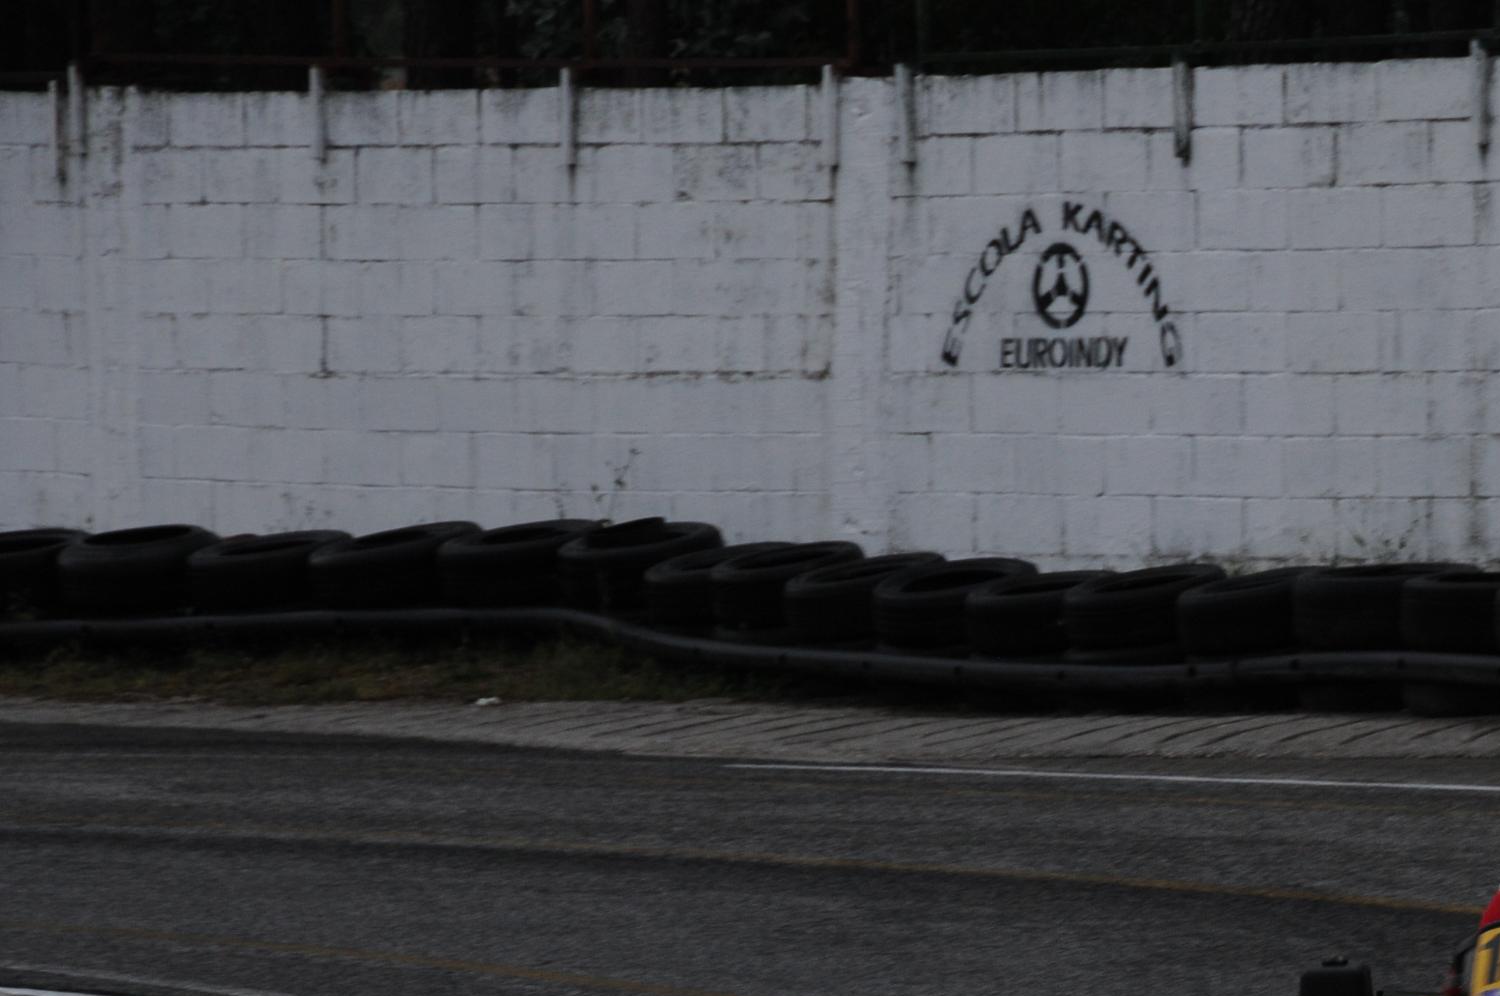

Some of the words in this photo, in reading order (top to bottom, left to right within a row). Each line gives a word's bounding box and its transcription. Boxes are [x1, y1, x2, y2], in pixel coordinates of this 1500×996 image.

[942, 209, 1042, 366] ESCOLA
[1063, 202, 1182, 367] KARTING
[1001, 337, 1128, 368] EUROINDY
